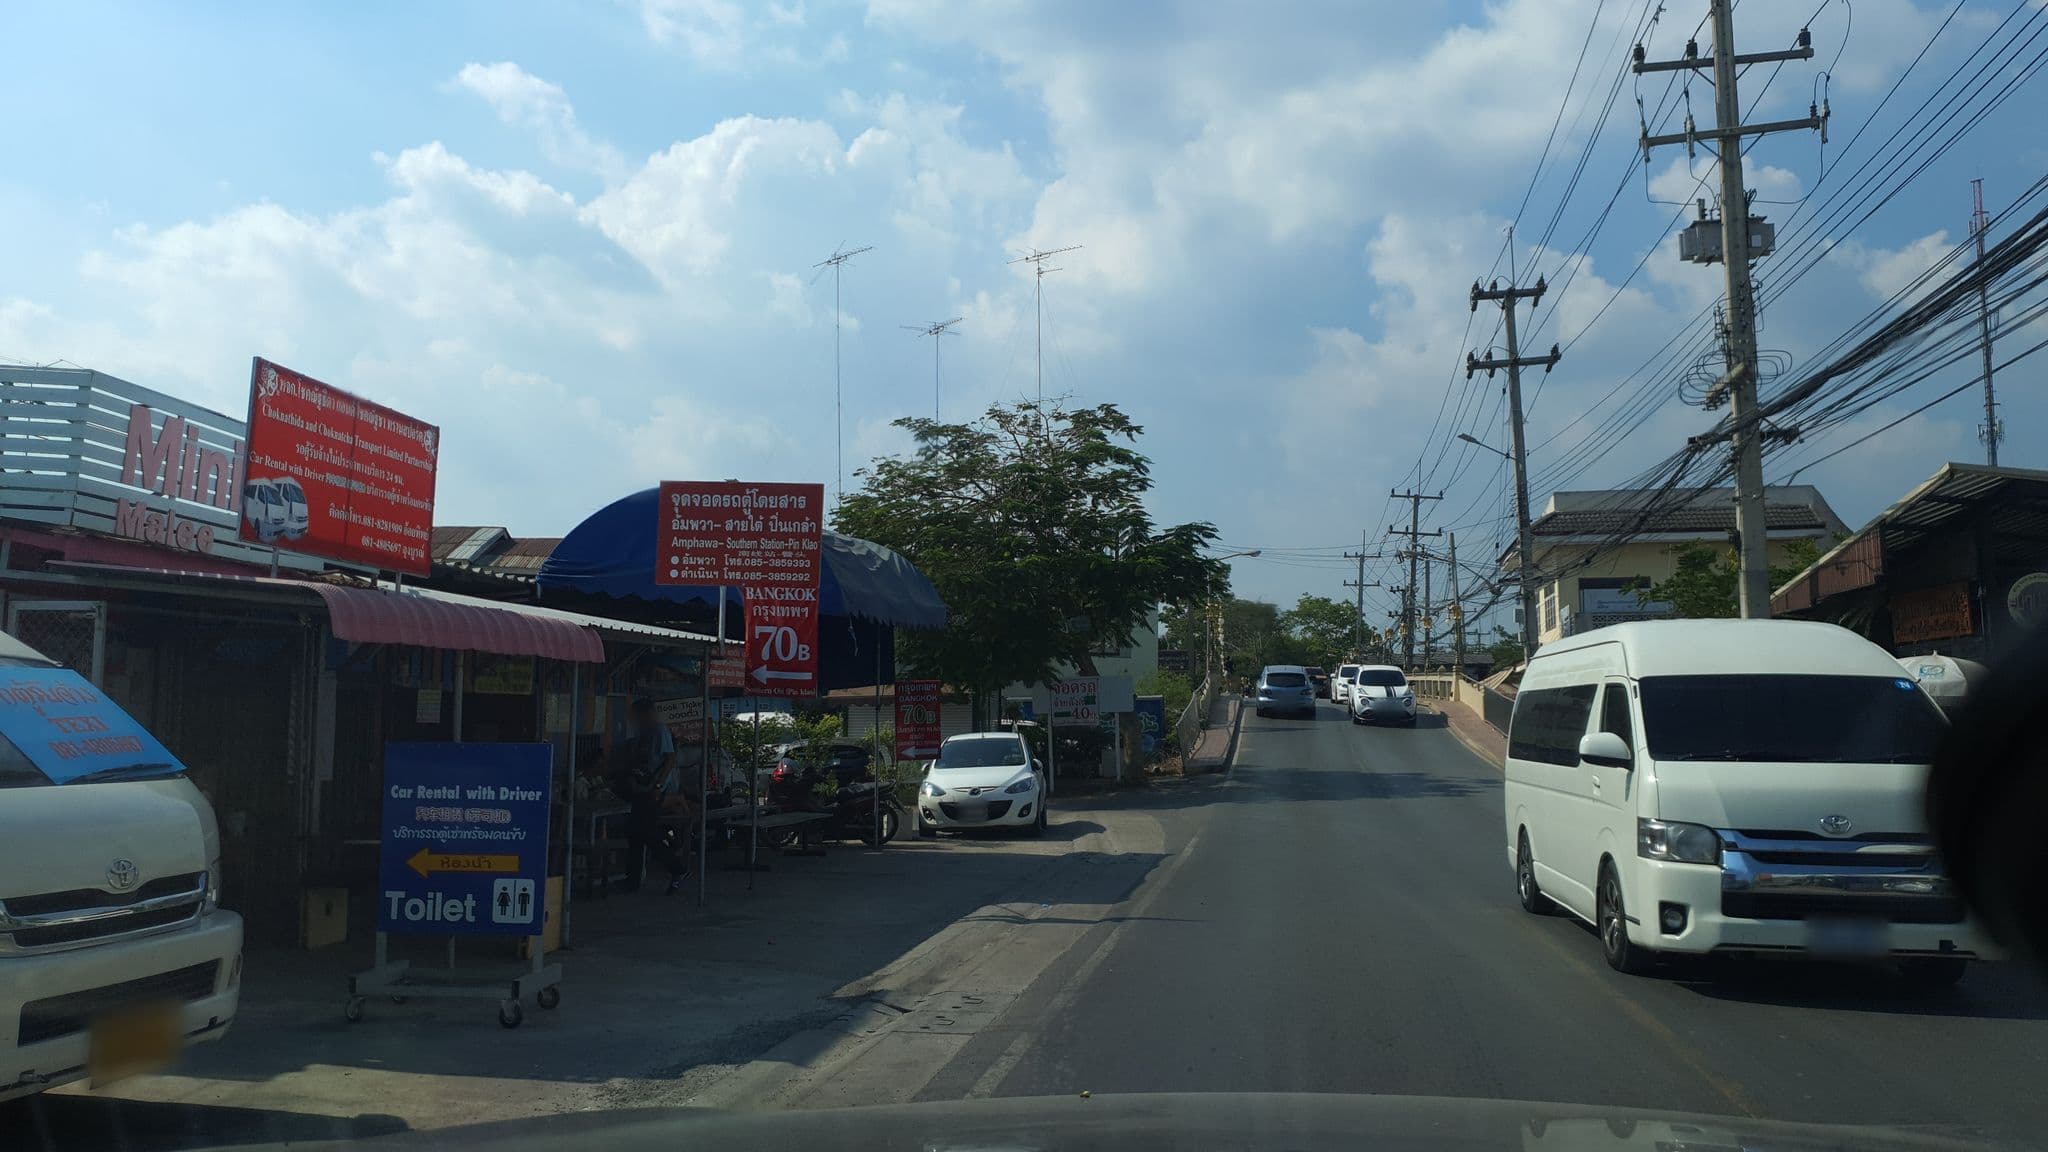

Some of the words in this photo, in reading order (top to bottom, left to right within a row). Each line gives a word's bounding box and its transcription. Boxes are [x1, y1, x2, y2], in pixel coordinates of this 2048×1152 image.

[305, 419, 317, 432] and
[382, 444, 403, 461] Limited
[121, 404, 246, 512] Mini
[264, 454, 287, 471] Rental
[288, 462, 303, 475] with
[304, 466, 325, 482] Driver
[386, 471, 393, 482] 24
[671, 489, 806, 515] จุดจอดรถตู้โดยสาร
[116, 497, 214, 553] Malee
[725, 515, 763, 532] สายใต้
[769, 512, 817, 532] ปิ่นเกล้า
[726, 537, 758, 549] Southern
[802, 538, 818, 550] Klao
[745, 586, 817, 601] BANGKOK
[753, 605, 809, 622] กรุงเทพฯ
[390, 784, 414, 799] Car
[417, 785, 460, 800] Rental
[466, 786, 496, 800] with
[499, 786, 543, 801] Driver
[393, 825, 527, 844] บริการรถตู้เช่าพร้อมคนขับ
[440, 856, 492, 869] ห้องน้ำ
[385, 890, 477, 923] Toilet
